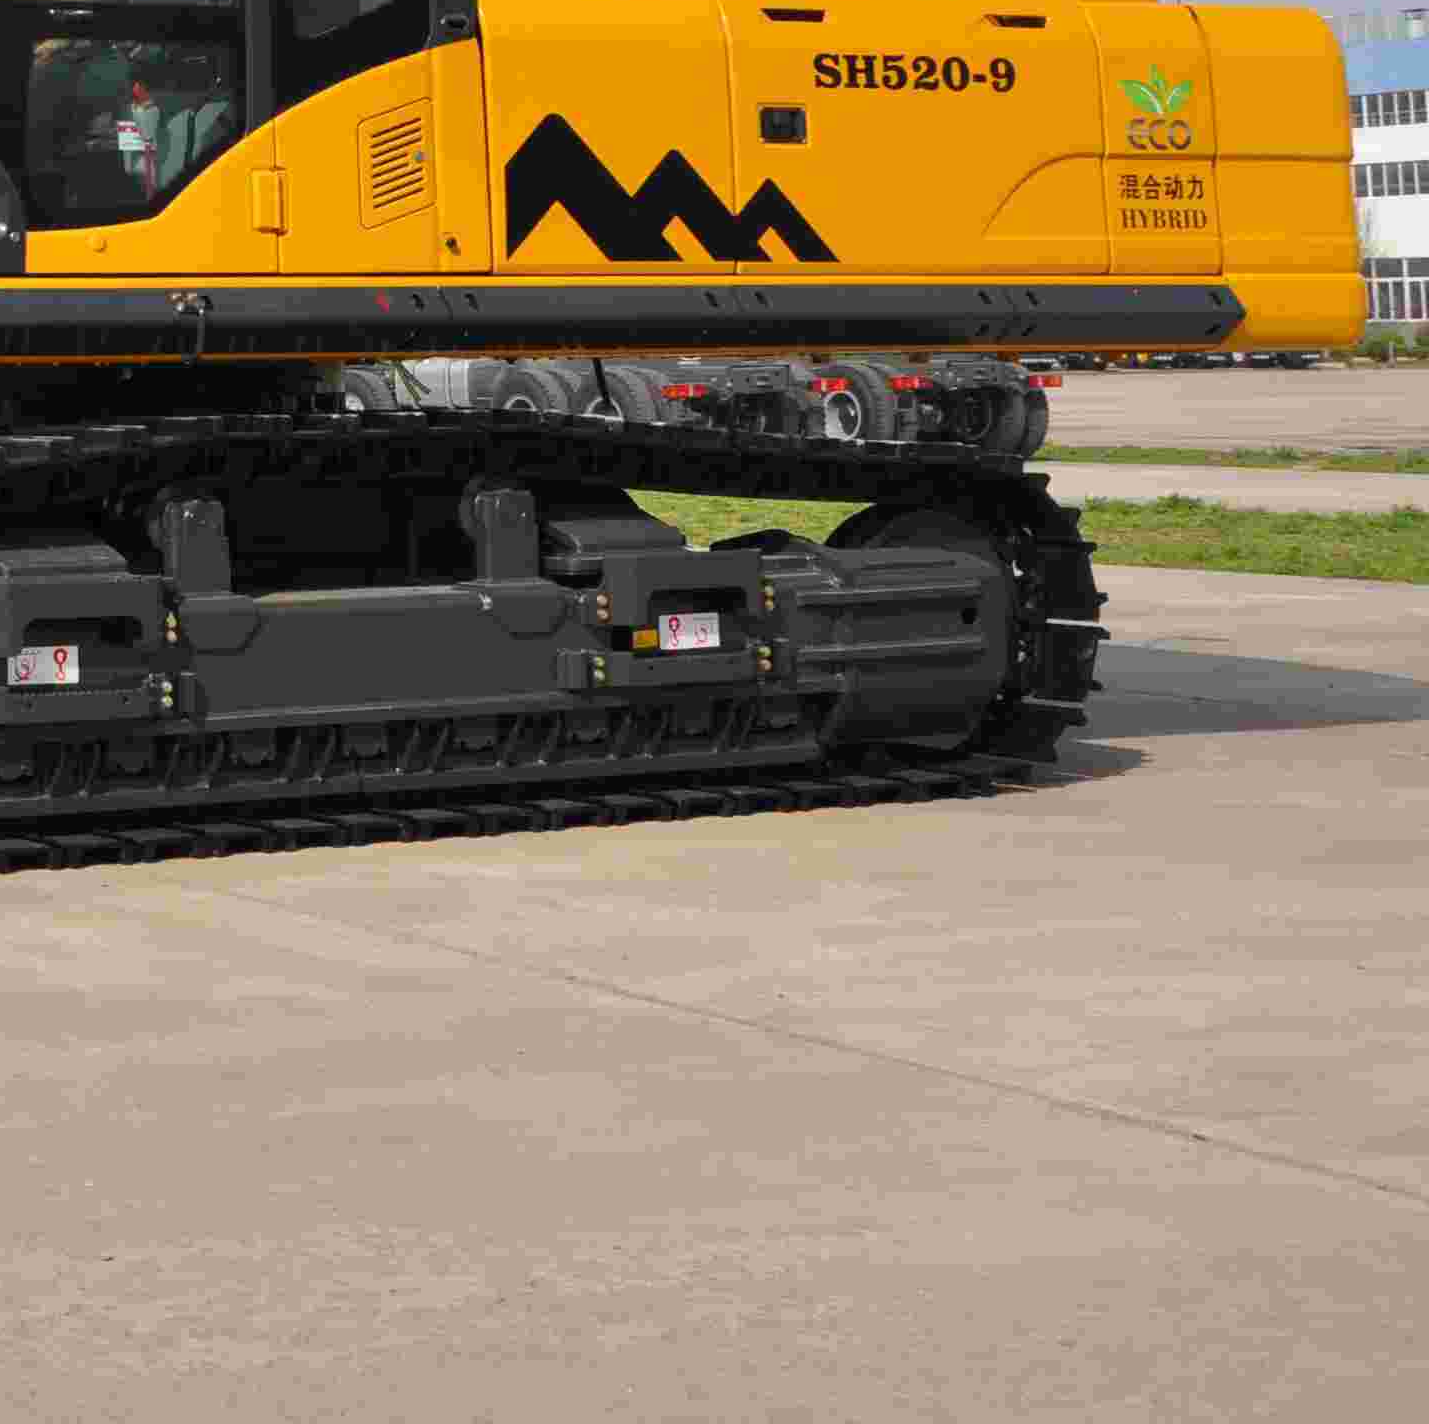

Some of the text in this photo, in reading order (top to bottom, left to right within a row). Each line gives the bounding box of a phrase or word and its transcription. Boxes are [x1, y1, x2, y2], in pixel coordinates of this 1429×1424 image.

[812, 53, 1015, 92] SH520-9
[1127, 118, 1192, 150] ECO
[1119, 175, 1205, 201] 混合动力
[1120, 207, 1207, 229] HYBRID
